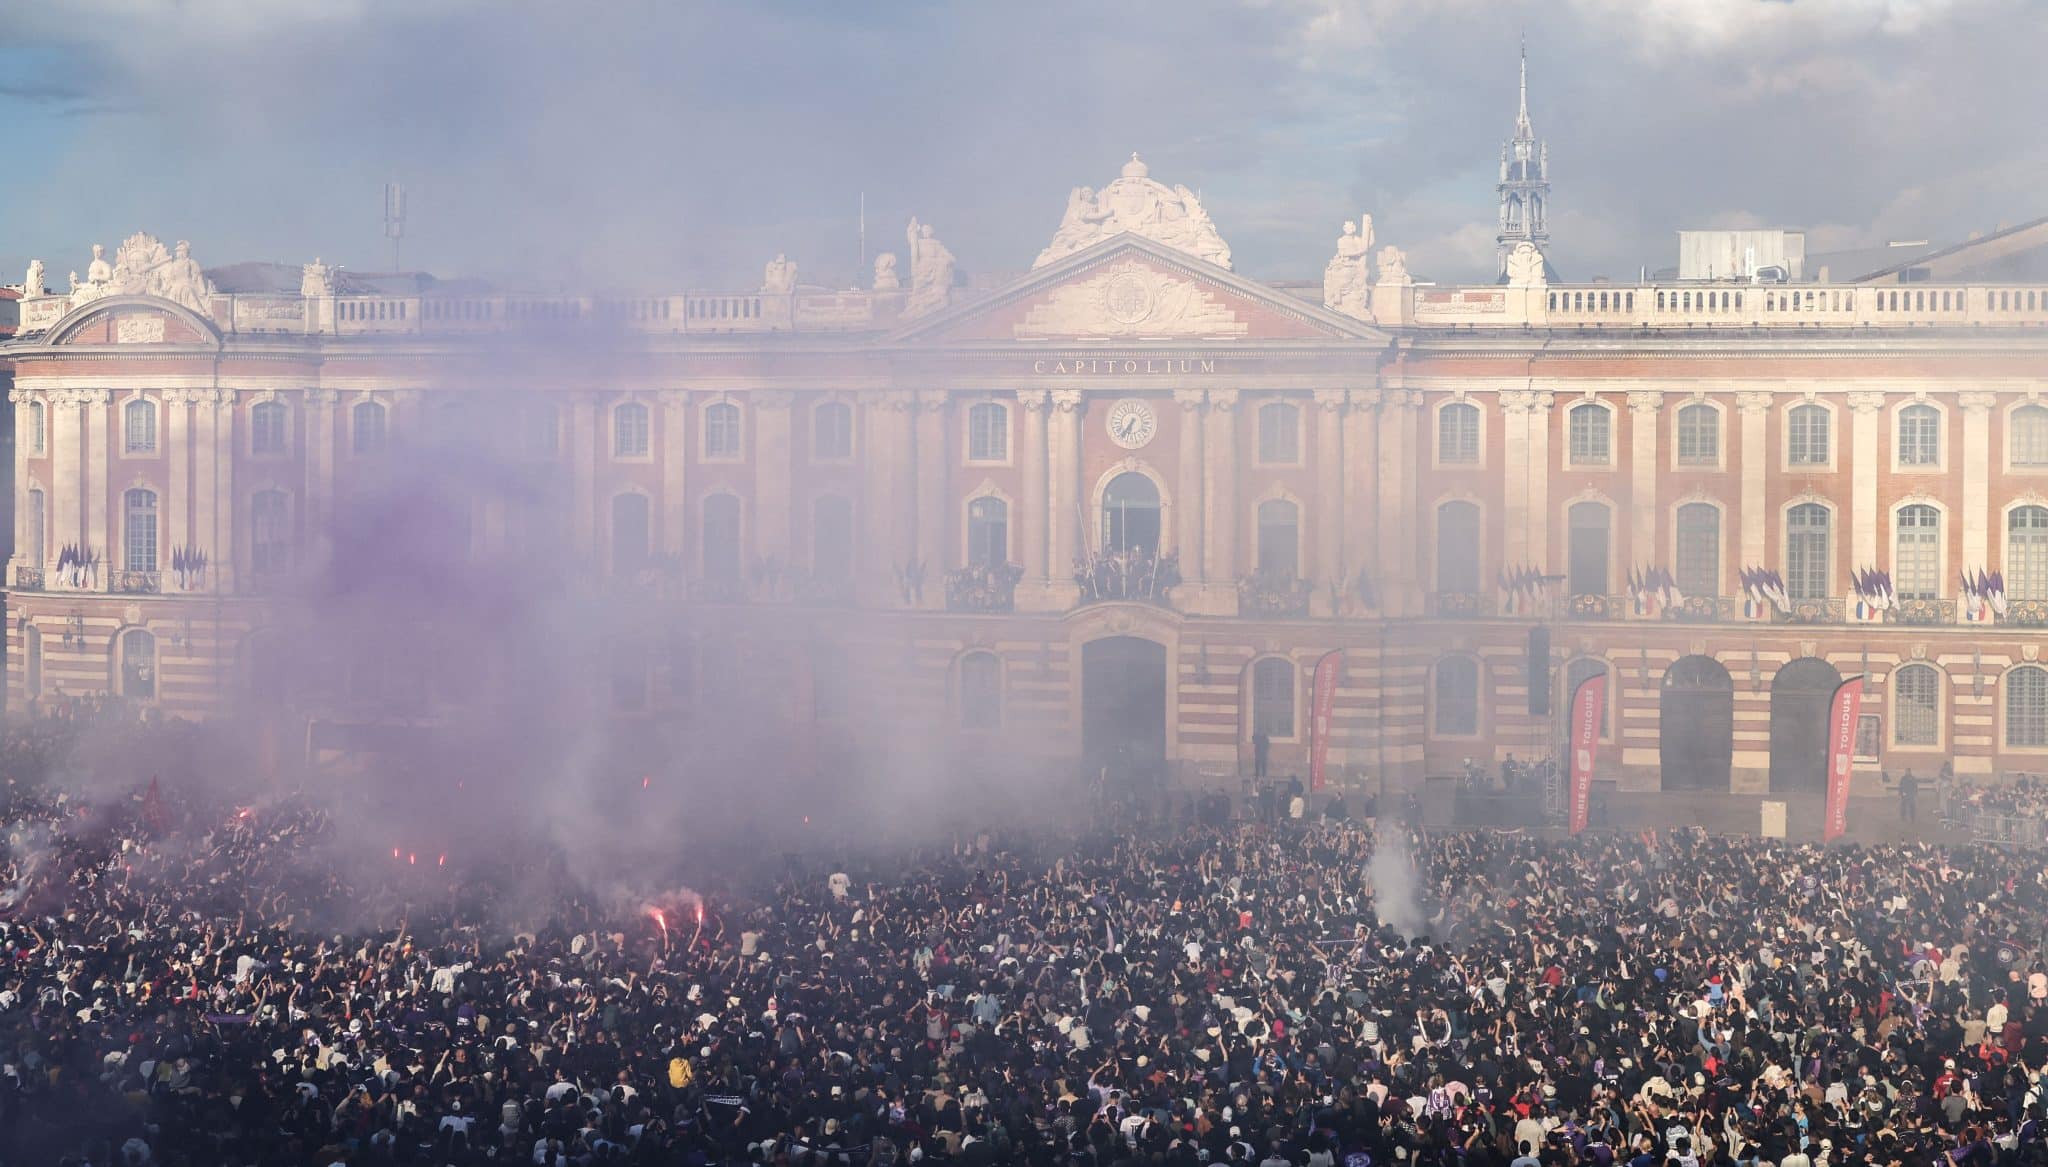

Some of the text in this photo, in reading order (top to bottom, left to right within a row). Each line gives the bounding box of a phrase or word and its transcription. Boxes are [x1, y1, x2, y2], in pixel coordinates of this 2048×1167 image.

[1034, 360, 1215, 374] CAPITOLIUM
[1583, 689, 1594, 745] TOULOUSE
[1840, 692, 1851, 749] TOULOUSE
